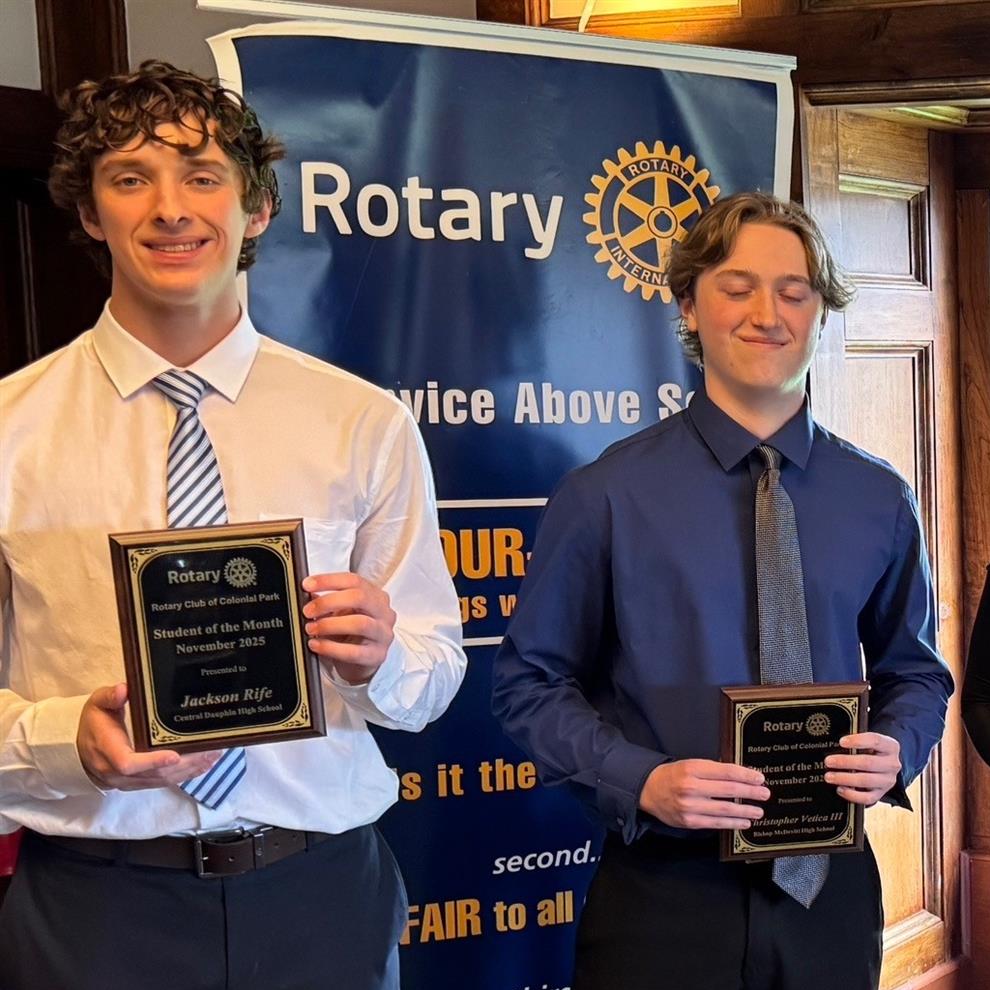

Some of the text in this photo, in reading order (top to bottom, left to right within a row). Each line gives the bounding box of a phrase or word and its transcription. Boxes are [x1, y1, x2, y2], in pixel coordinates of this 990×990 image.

[628, 159, 689, 179] ROTARY
[300, 161, 564, 260] Rotary
[399, 381, 495, 424] vice
[514, 382, 640, 424] Above
[168, 569, 220, 584] Rotary
[152, 593, 280, 612] Rotary Club of Colonial Park
[153, 618, 283, 640] Student of the Month
[176, 637, 266, 654] November 2025
[201, 665, 247, 676] Presented to
[181, 687, 273, 709] Jackson Rife
[174, 713, 203, 723] Central
[258, 704, 283, 714] School
[764, 720, 803, 732] Rotary
[748, 745, 771, 753] Rotary
[786, 764, 796, 772] of
[797, 762, 812, 771] the
[437, 764, 464, 797] it
[479, 758, 537, 792] the
[809, 775, 824, 783] 202
[751, 816, 799, 827] hristopher
[400, 890, 574, 945] FAIR to all
